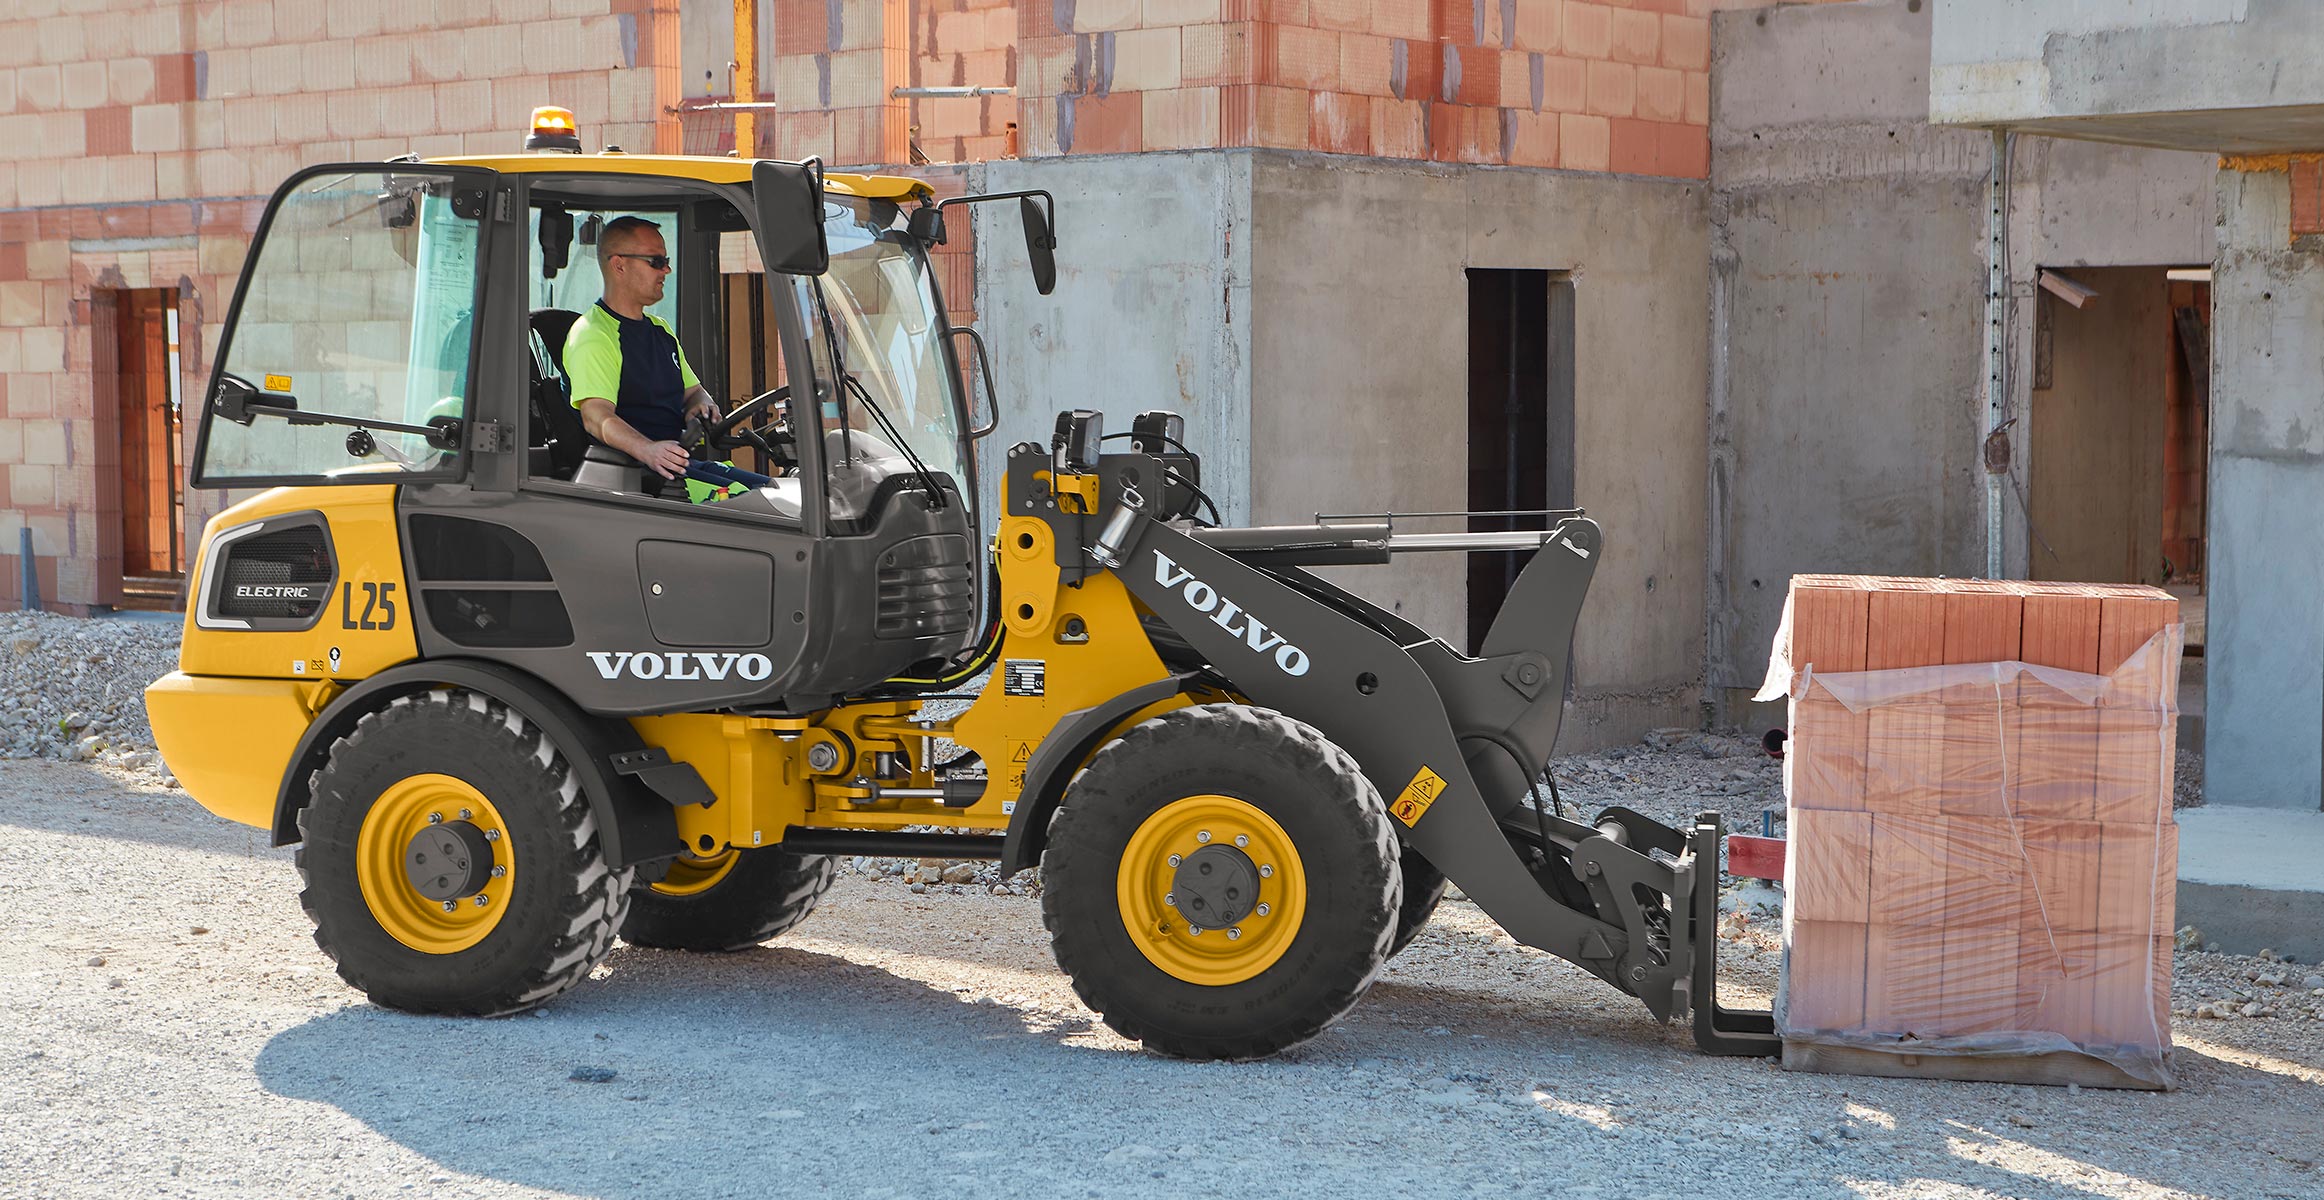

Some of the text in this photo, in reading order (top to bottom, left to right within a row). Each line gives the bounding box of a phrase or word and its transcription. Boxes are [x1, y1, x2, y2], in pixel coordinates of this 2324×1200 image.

[236, 586, 309, 598] ELECTRIC
[342, 582, 396, 630] L25
[1153, 549, 1310, 676] VOLVO
[586, 652, 772, 681] VOLVO
